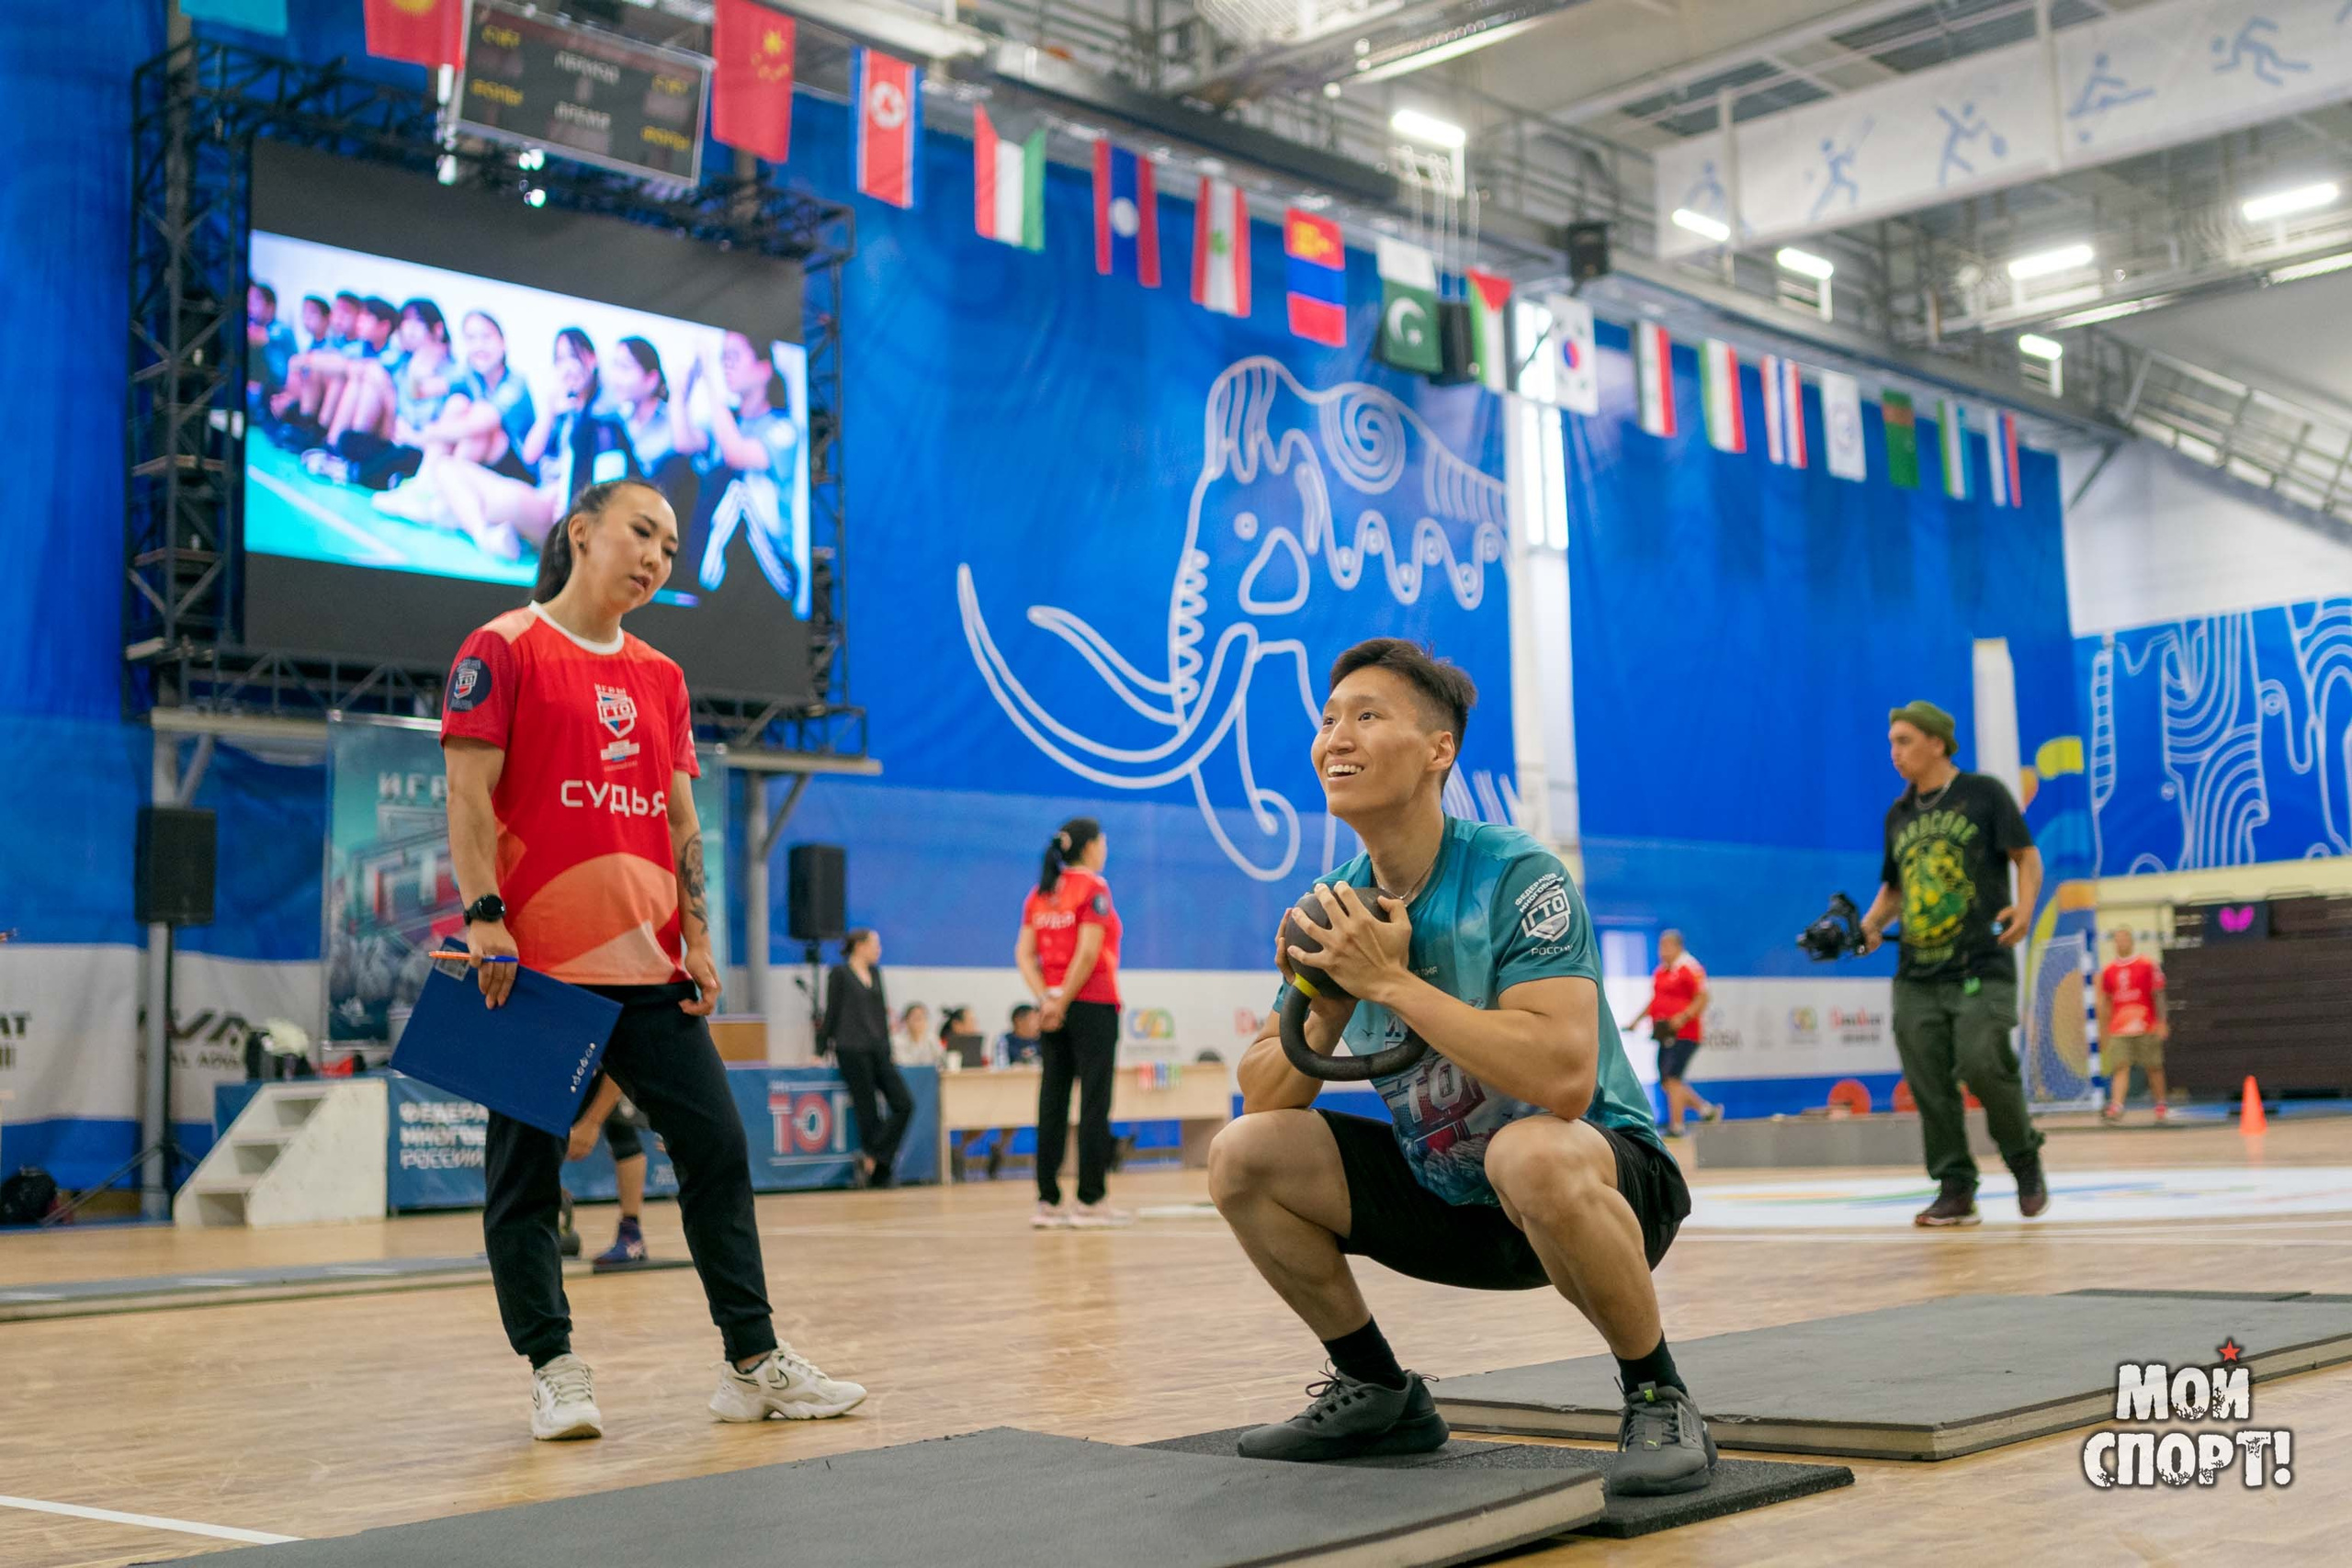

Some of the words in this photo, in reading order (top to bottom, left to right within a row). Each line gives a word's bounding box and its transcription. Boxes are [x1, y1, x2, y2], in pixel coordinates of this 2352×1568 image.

[602, 703, 631, 718] ГТО
[560, 780, 668, 818] СУДЬЯ
[1527, 896, 1566, 930] ГТО
[399, 1101, 489, 1123] ФЕДЕРА
